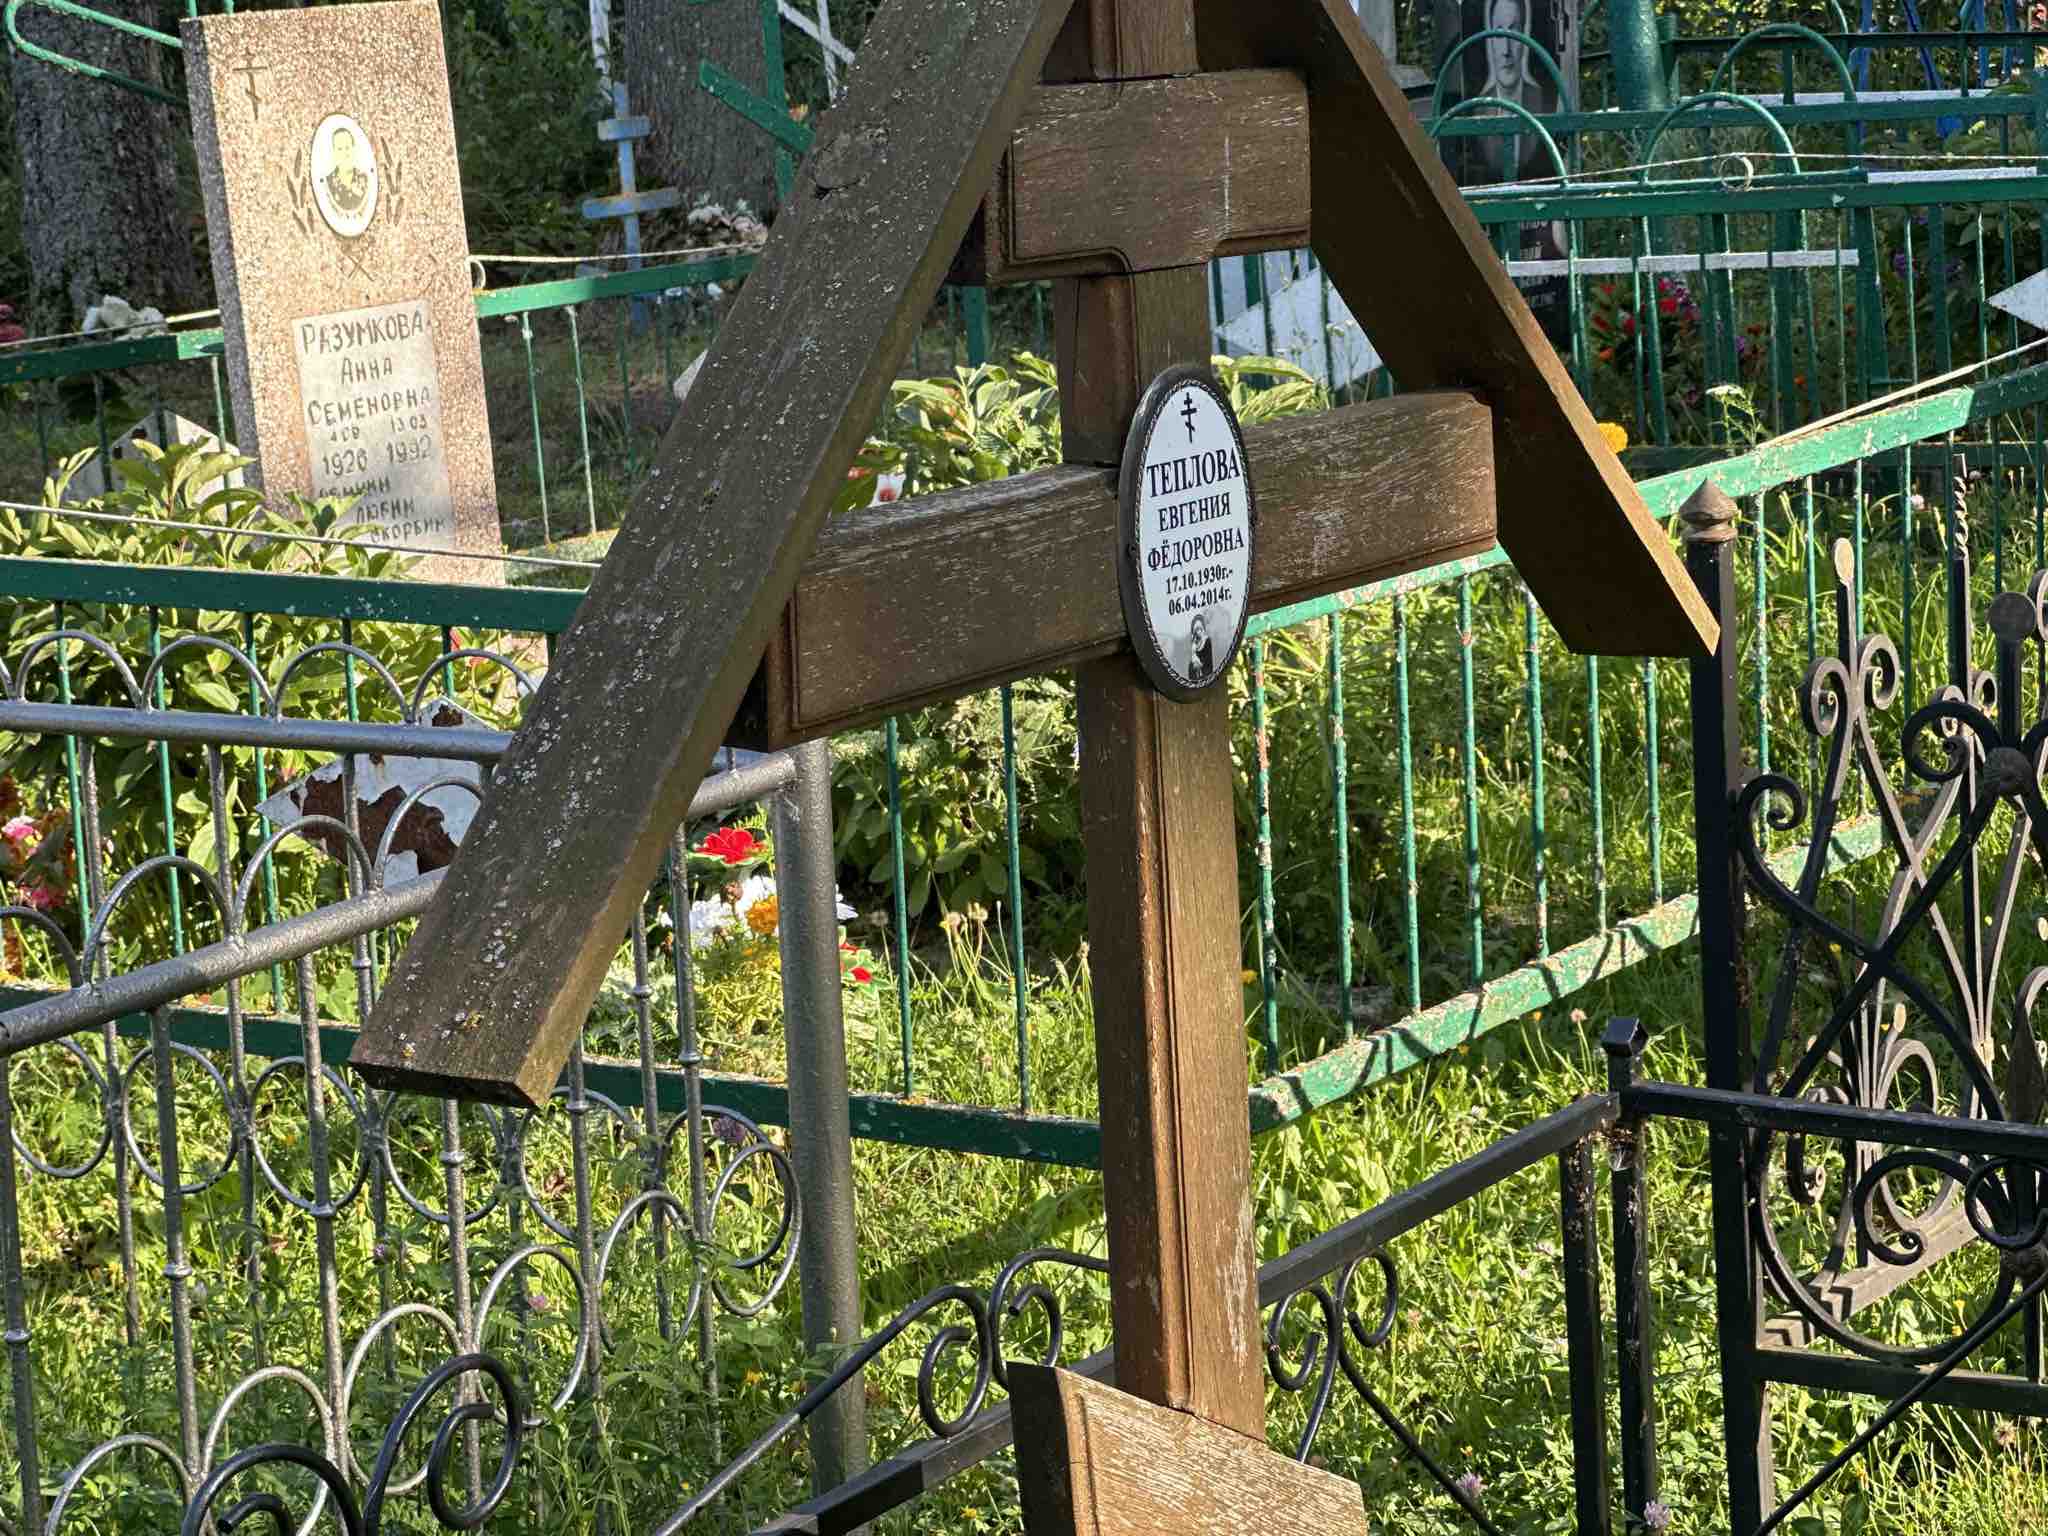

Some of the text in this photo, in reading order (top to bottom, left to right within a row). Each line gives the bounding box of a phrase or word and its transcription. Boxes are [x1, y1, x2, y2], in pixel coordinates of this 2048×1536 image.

[302, 310, 424, 354] РАЗУМКОВА
[341, 357, 393, 385] АННА
[308, 387, 431, 426] СЕМЕНОВНА
[1147, 448, 1240, 497] ТЕПЛОВА
[1158, 492, 1231, 531] ЕВГЕНИЯ
[1148, 528, 1244, 572] ФЁДОРОВНА
[1169, 586, 1232, 616] 06.04.2014г.
